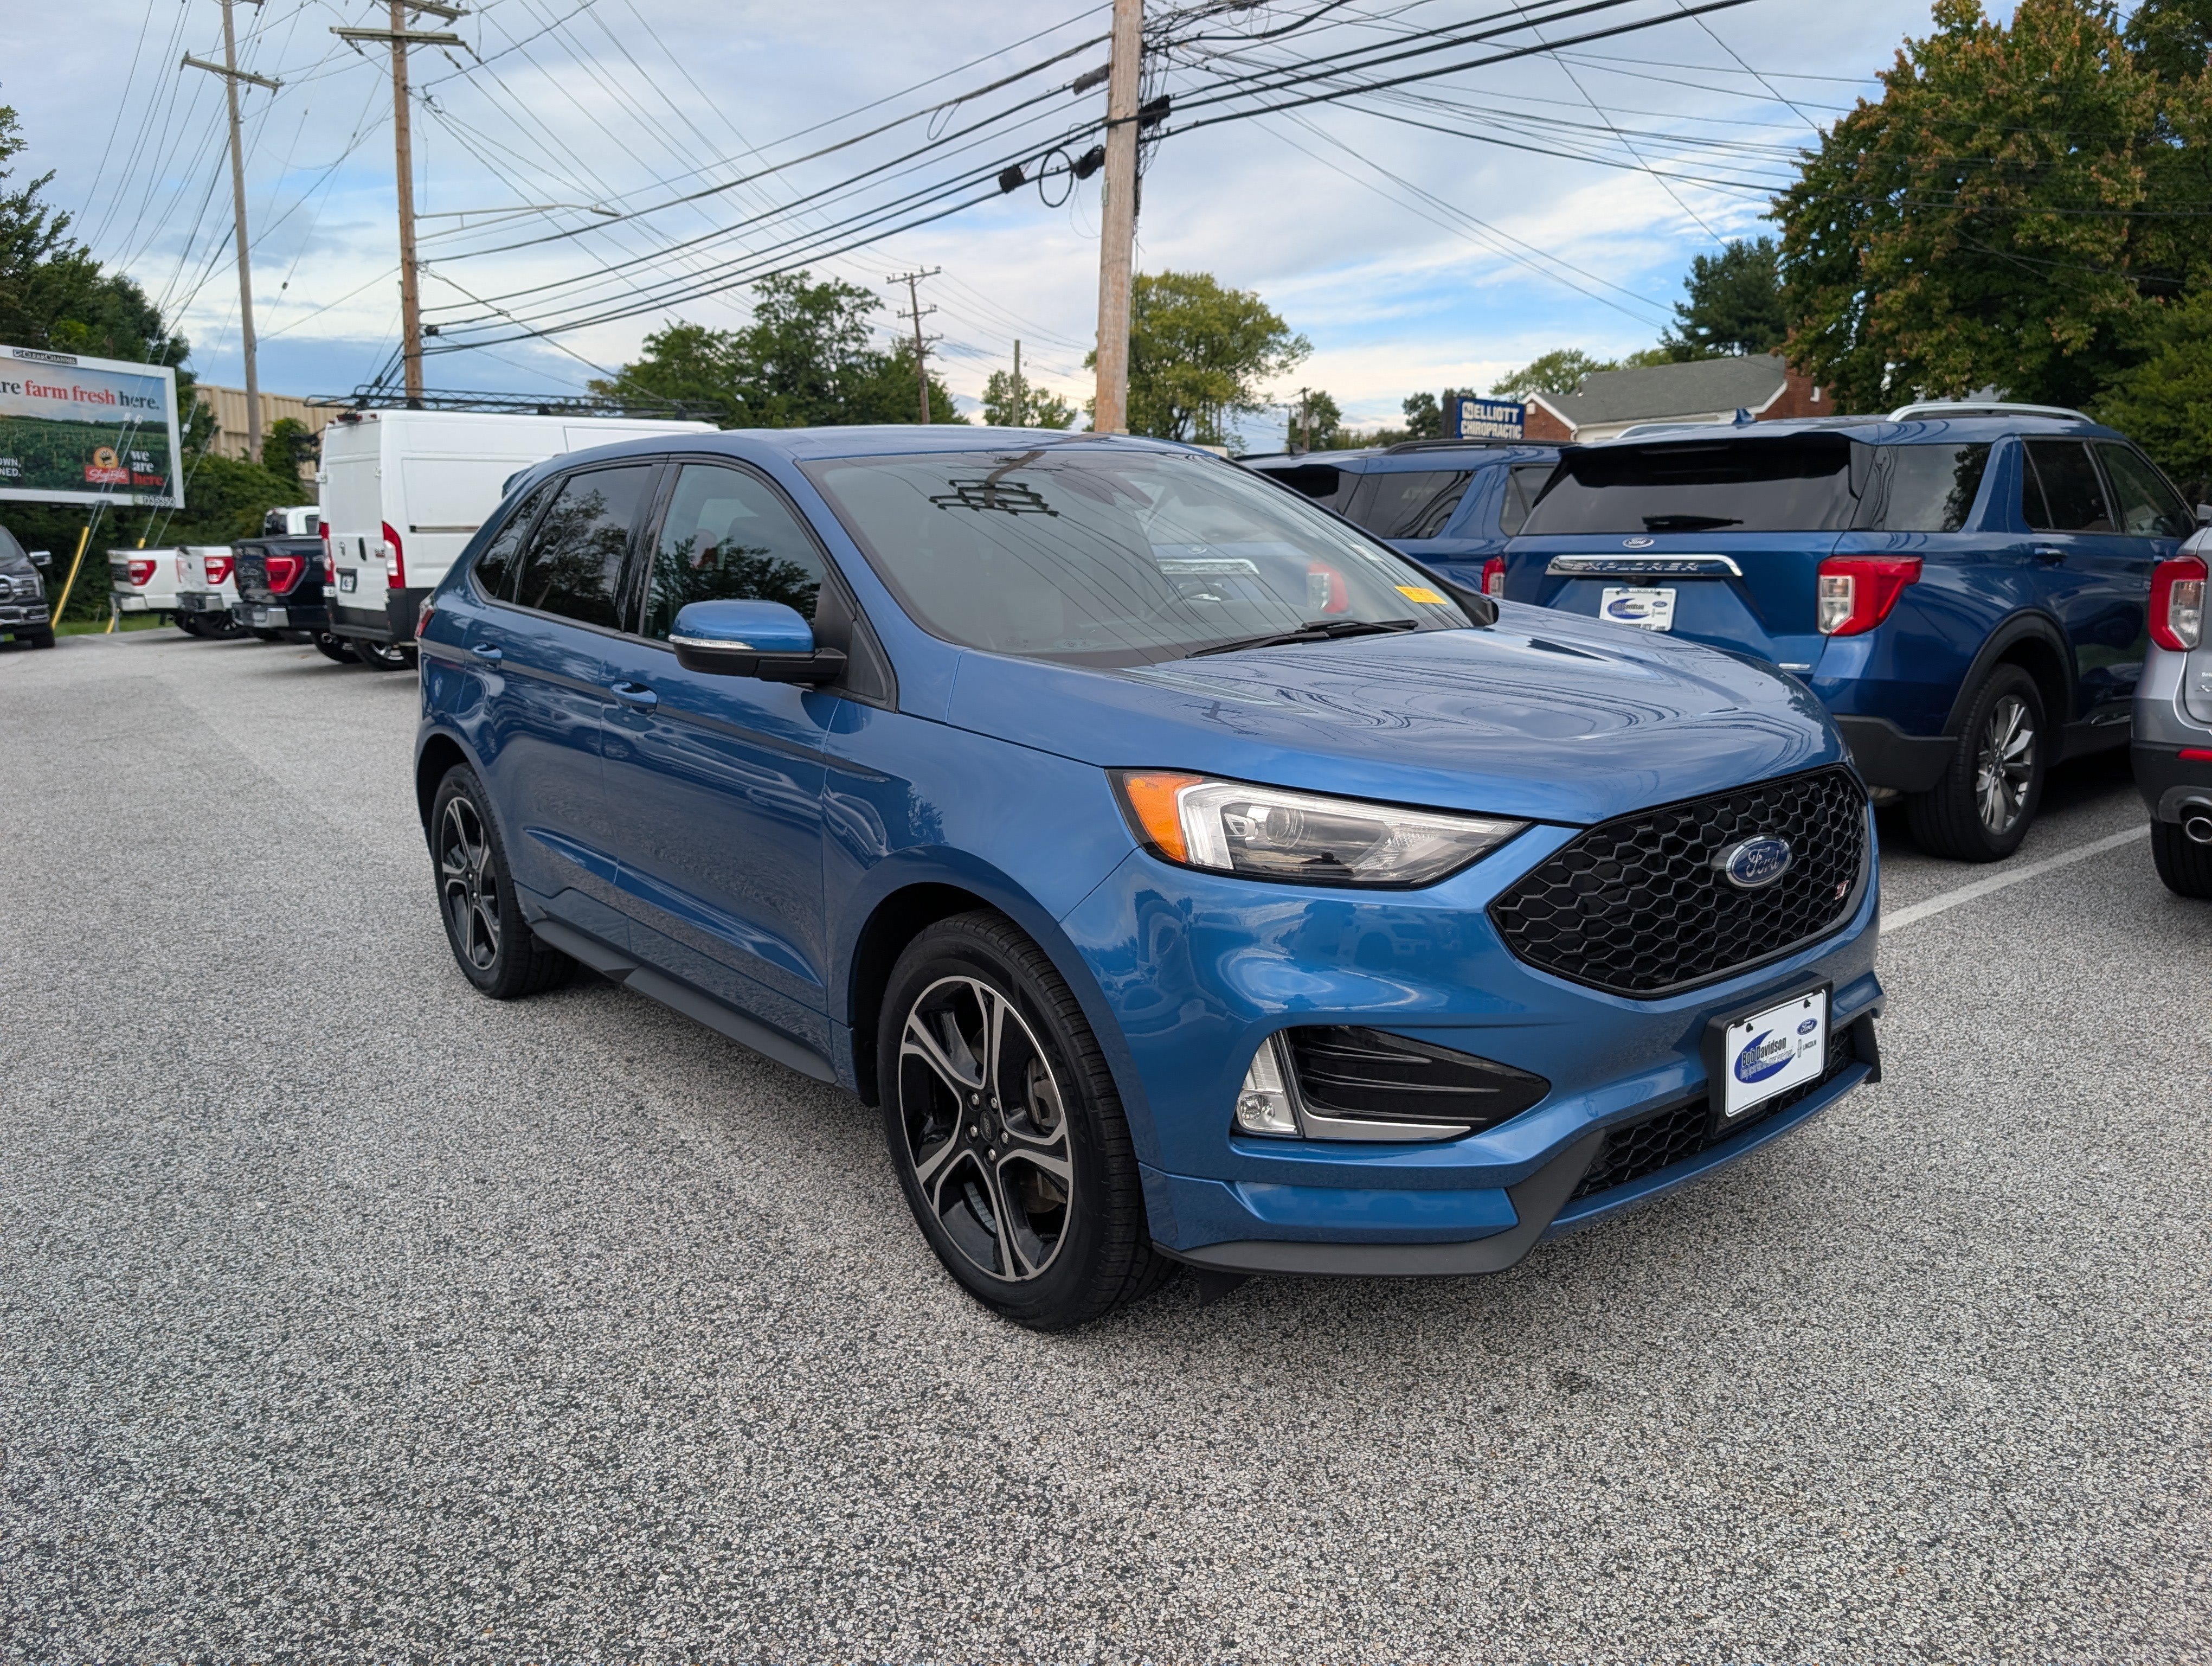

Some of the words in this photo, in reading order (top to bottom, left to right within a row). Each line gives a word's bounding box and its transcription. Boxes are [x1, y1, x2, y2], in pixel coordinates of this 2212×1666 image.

[0, 381, 22, 395] re
[25, 380, 68, 400] farm
[72, 386, 116, 405] fresh
[120, 390, 160, 410] here.
[1473, 404, 1520, 422] ELLIOTT
[1460, 420, 1522, 440] CHIROPRACTIC
[130, 450, 150, 462] we
[132, 462, 154, 473] are
[133, 472, 165, 486] here.
[1572, 561, 1699, 571] EXPLORER
[1746, 846, 1781, 877] Ford
[1742, 1048, 1755, 1067] Bob
[1756, 1036, 1787, 1060] Davidson
